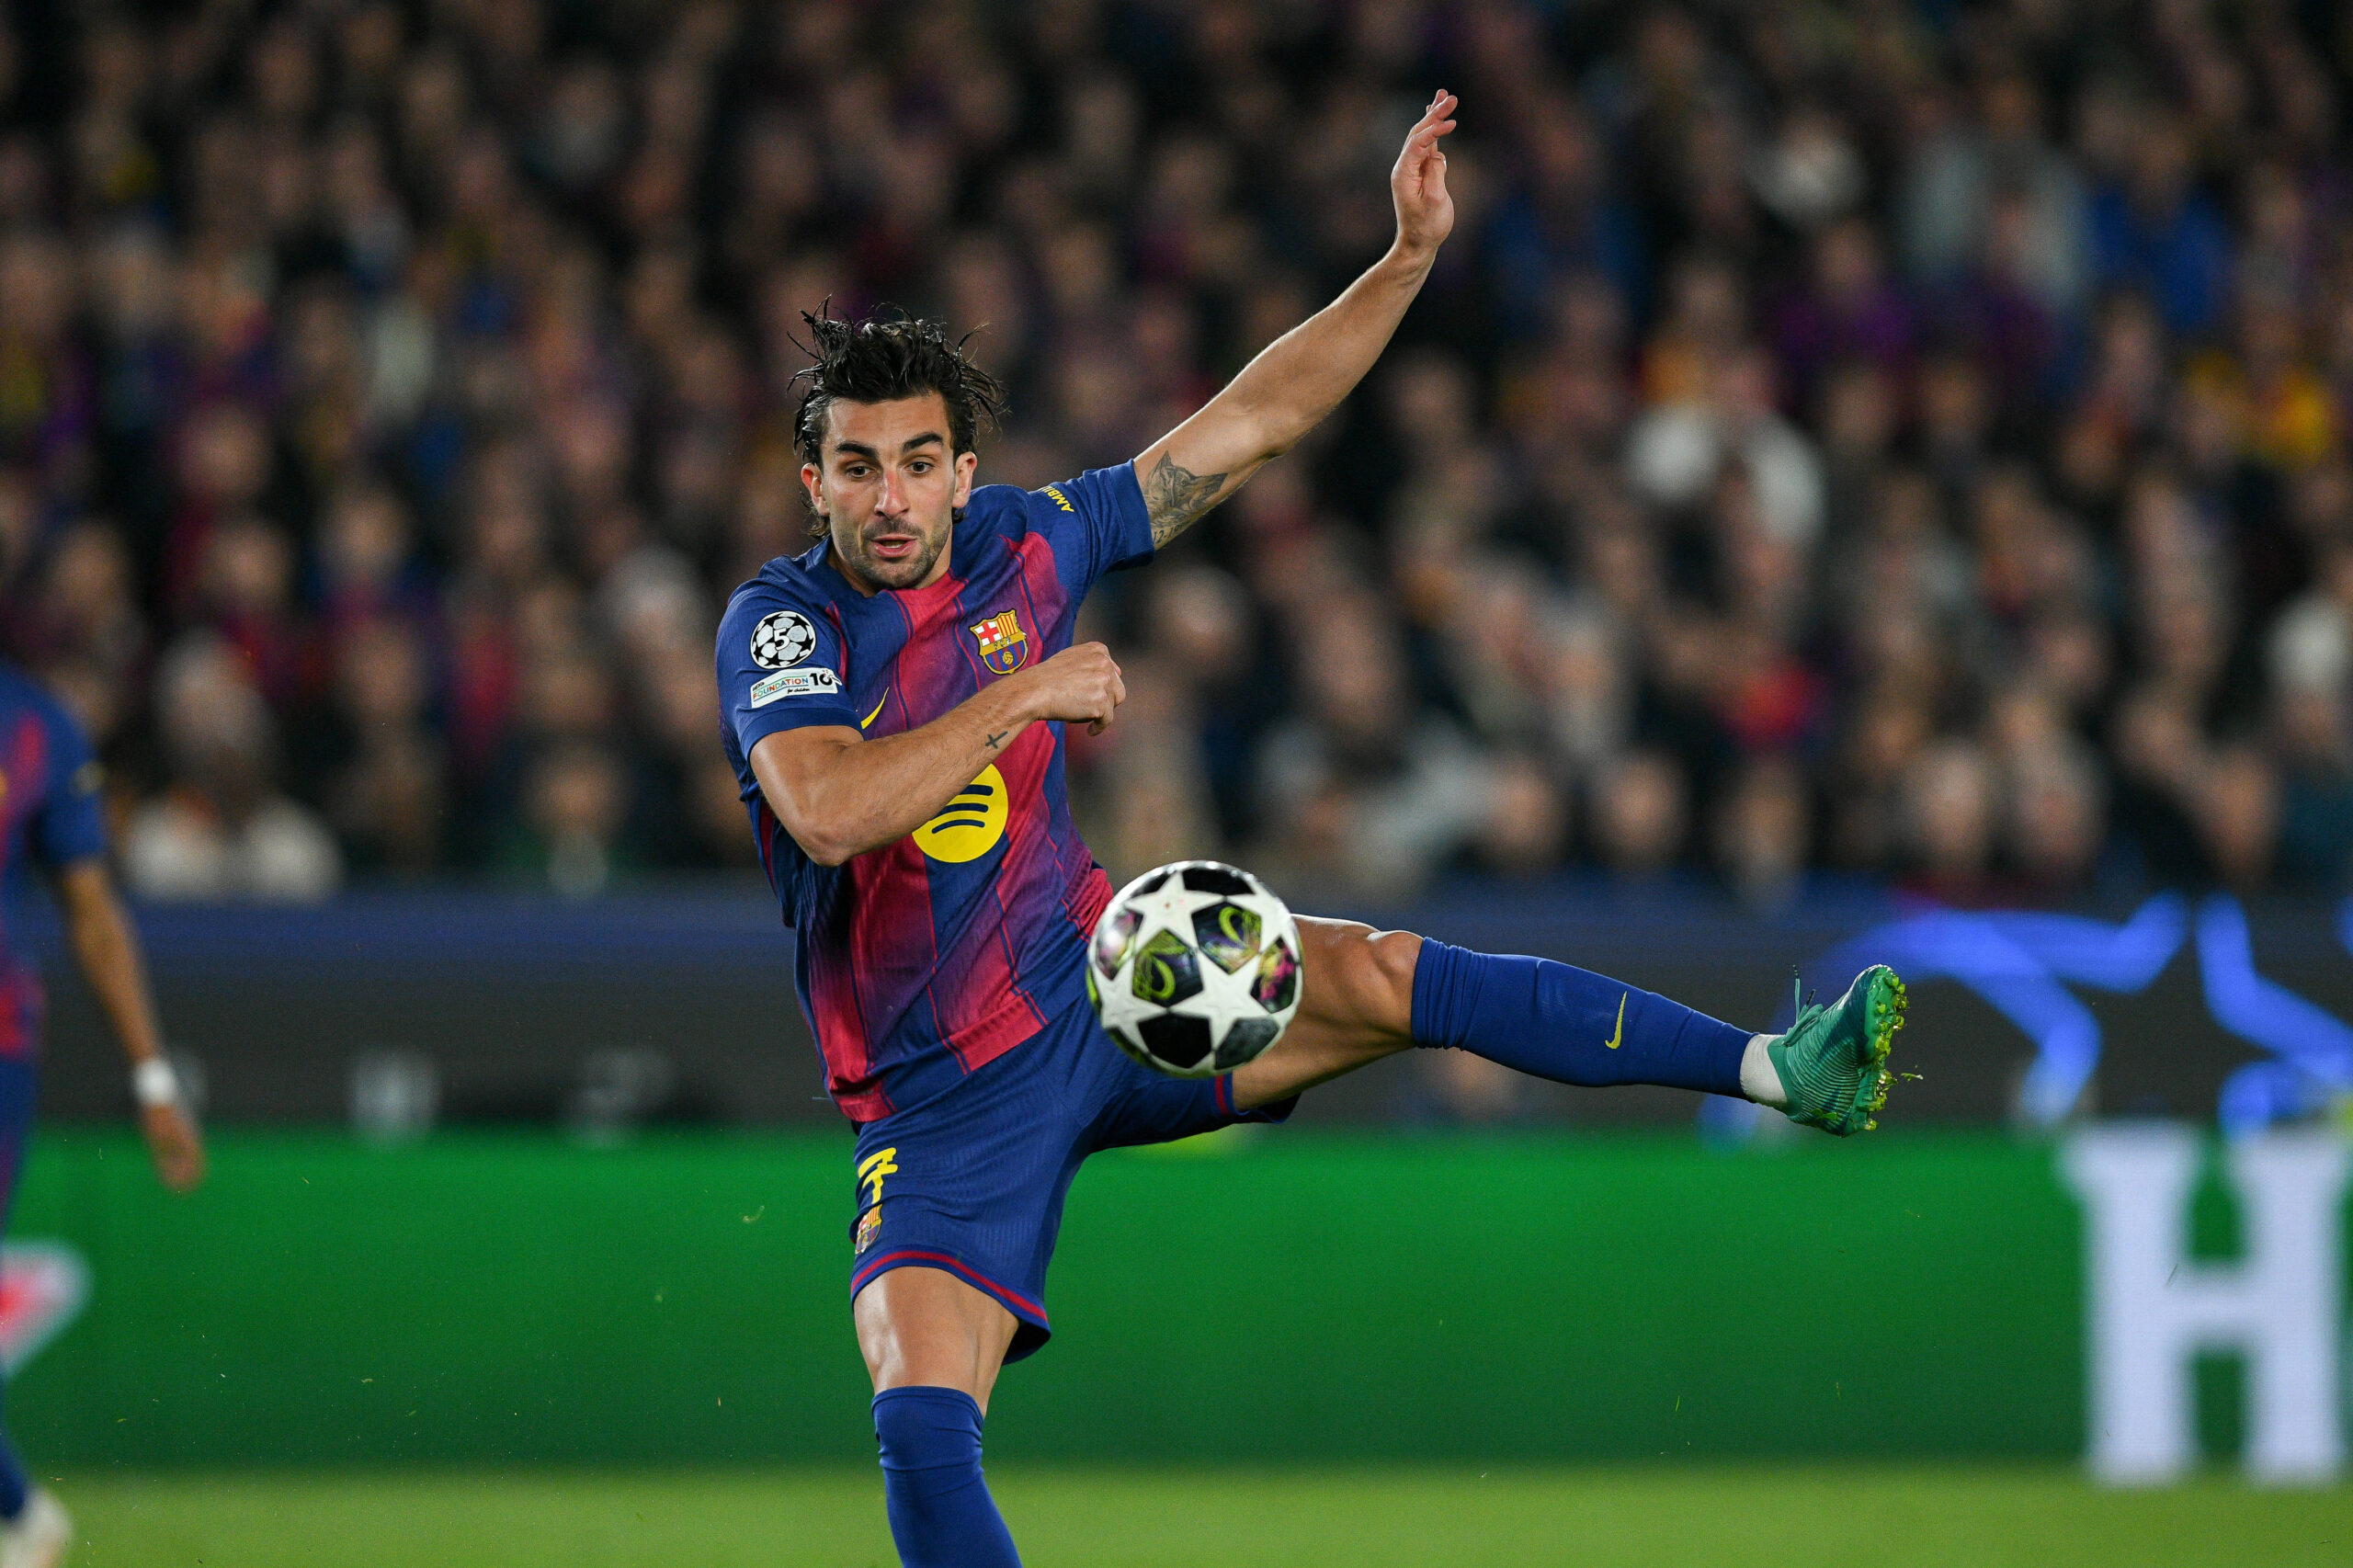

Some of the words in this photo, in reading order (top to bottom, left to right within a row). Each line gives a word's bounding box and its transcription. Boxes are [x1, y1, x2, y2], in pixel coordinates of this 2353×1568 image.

[774, 628, 790, 650] 5
[810, 672, 833, 686] 10
[858, 1147, 898, 1204] 7
